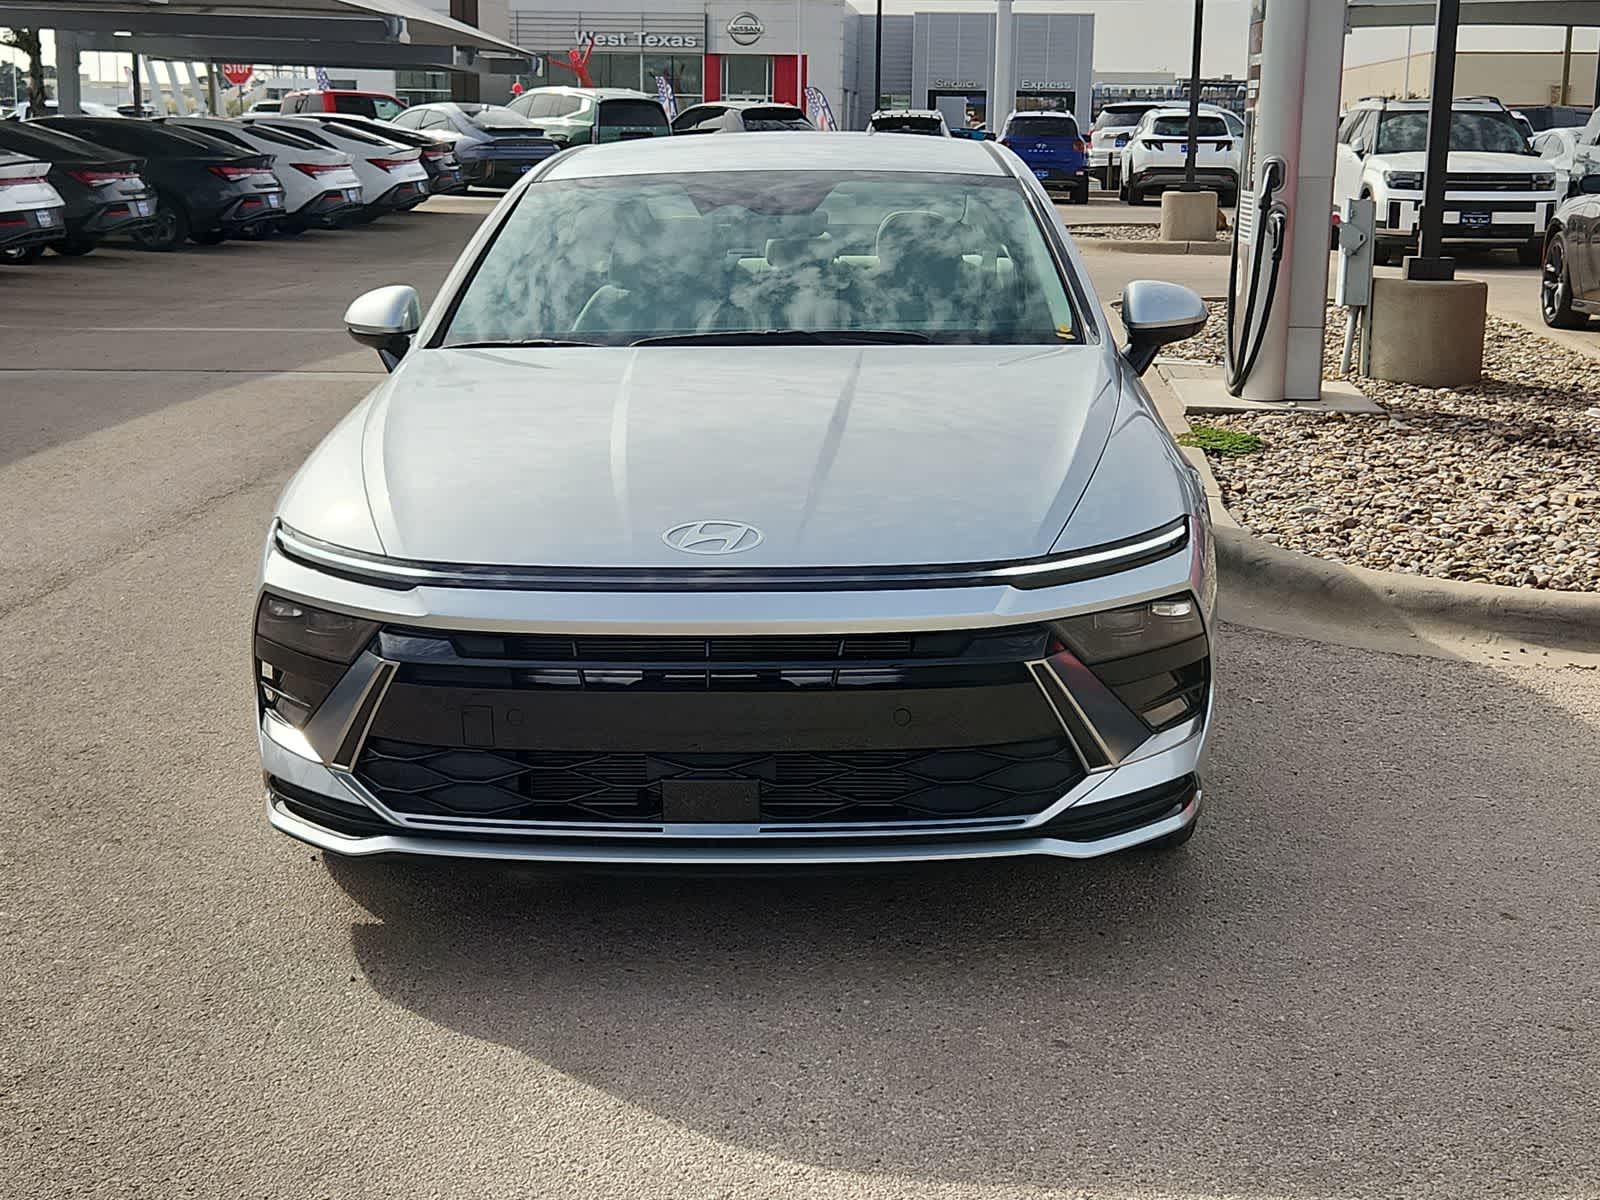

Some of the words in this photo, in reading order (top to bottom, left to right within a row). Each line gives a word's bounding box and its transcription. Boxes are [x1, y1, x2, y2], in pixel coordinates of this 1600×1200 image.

[575, 31, 627, 47] West
[634, 31, 697, 47] Texas
[225, 64, 250, 74] STOP
[1021, 79, 1071, 90] Express
